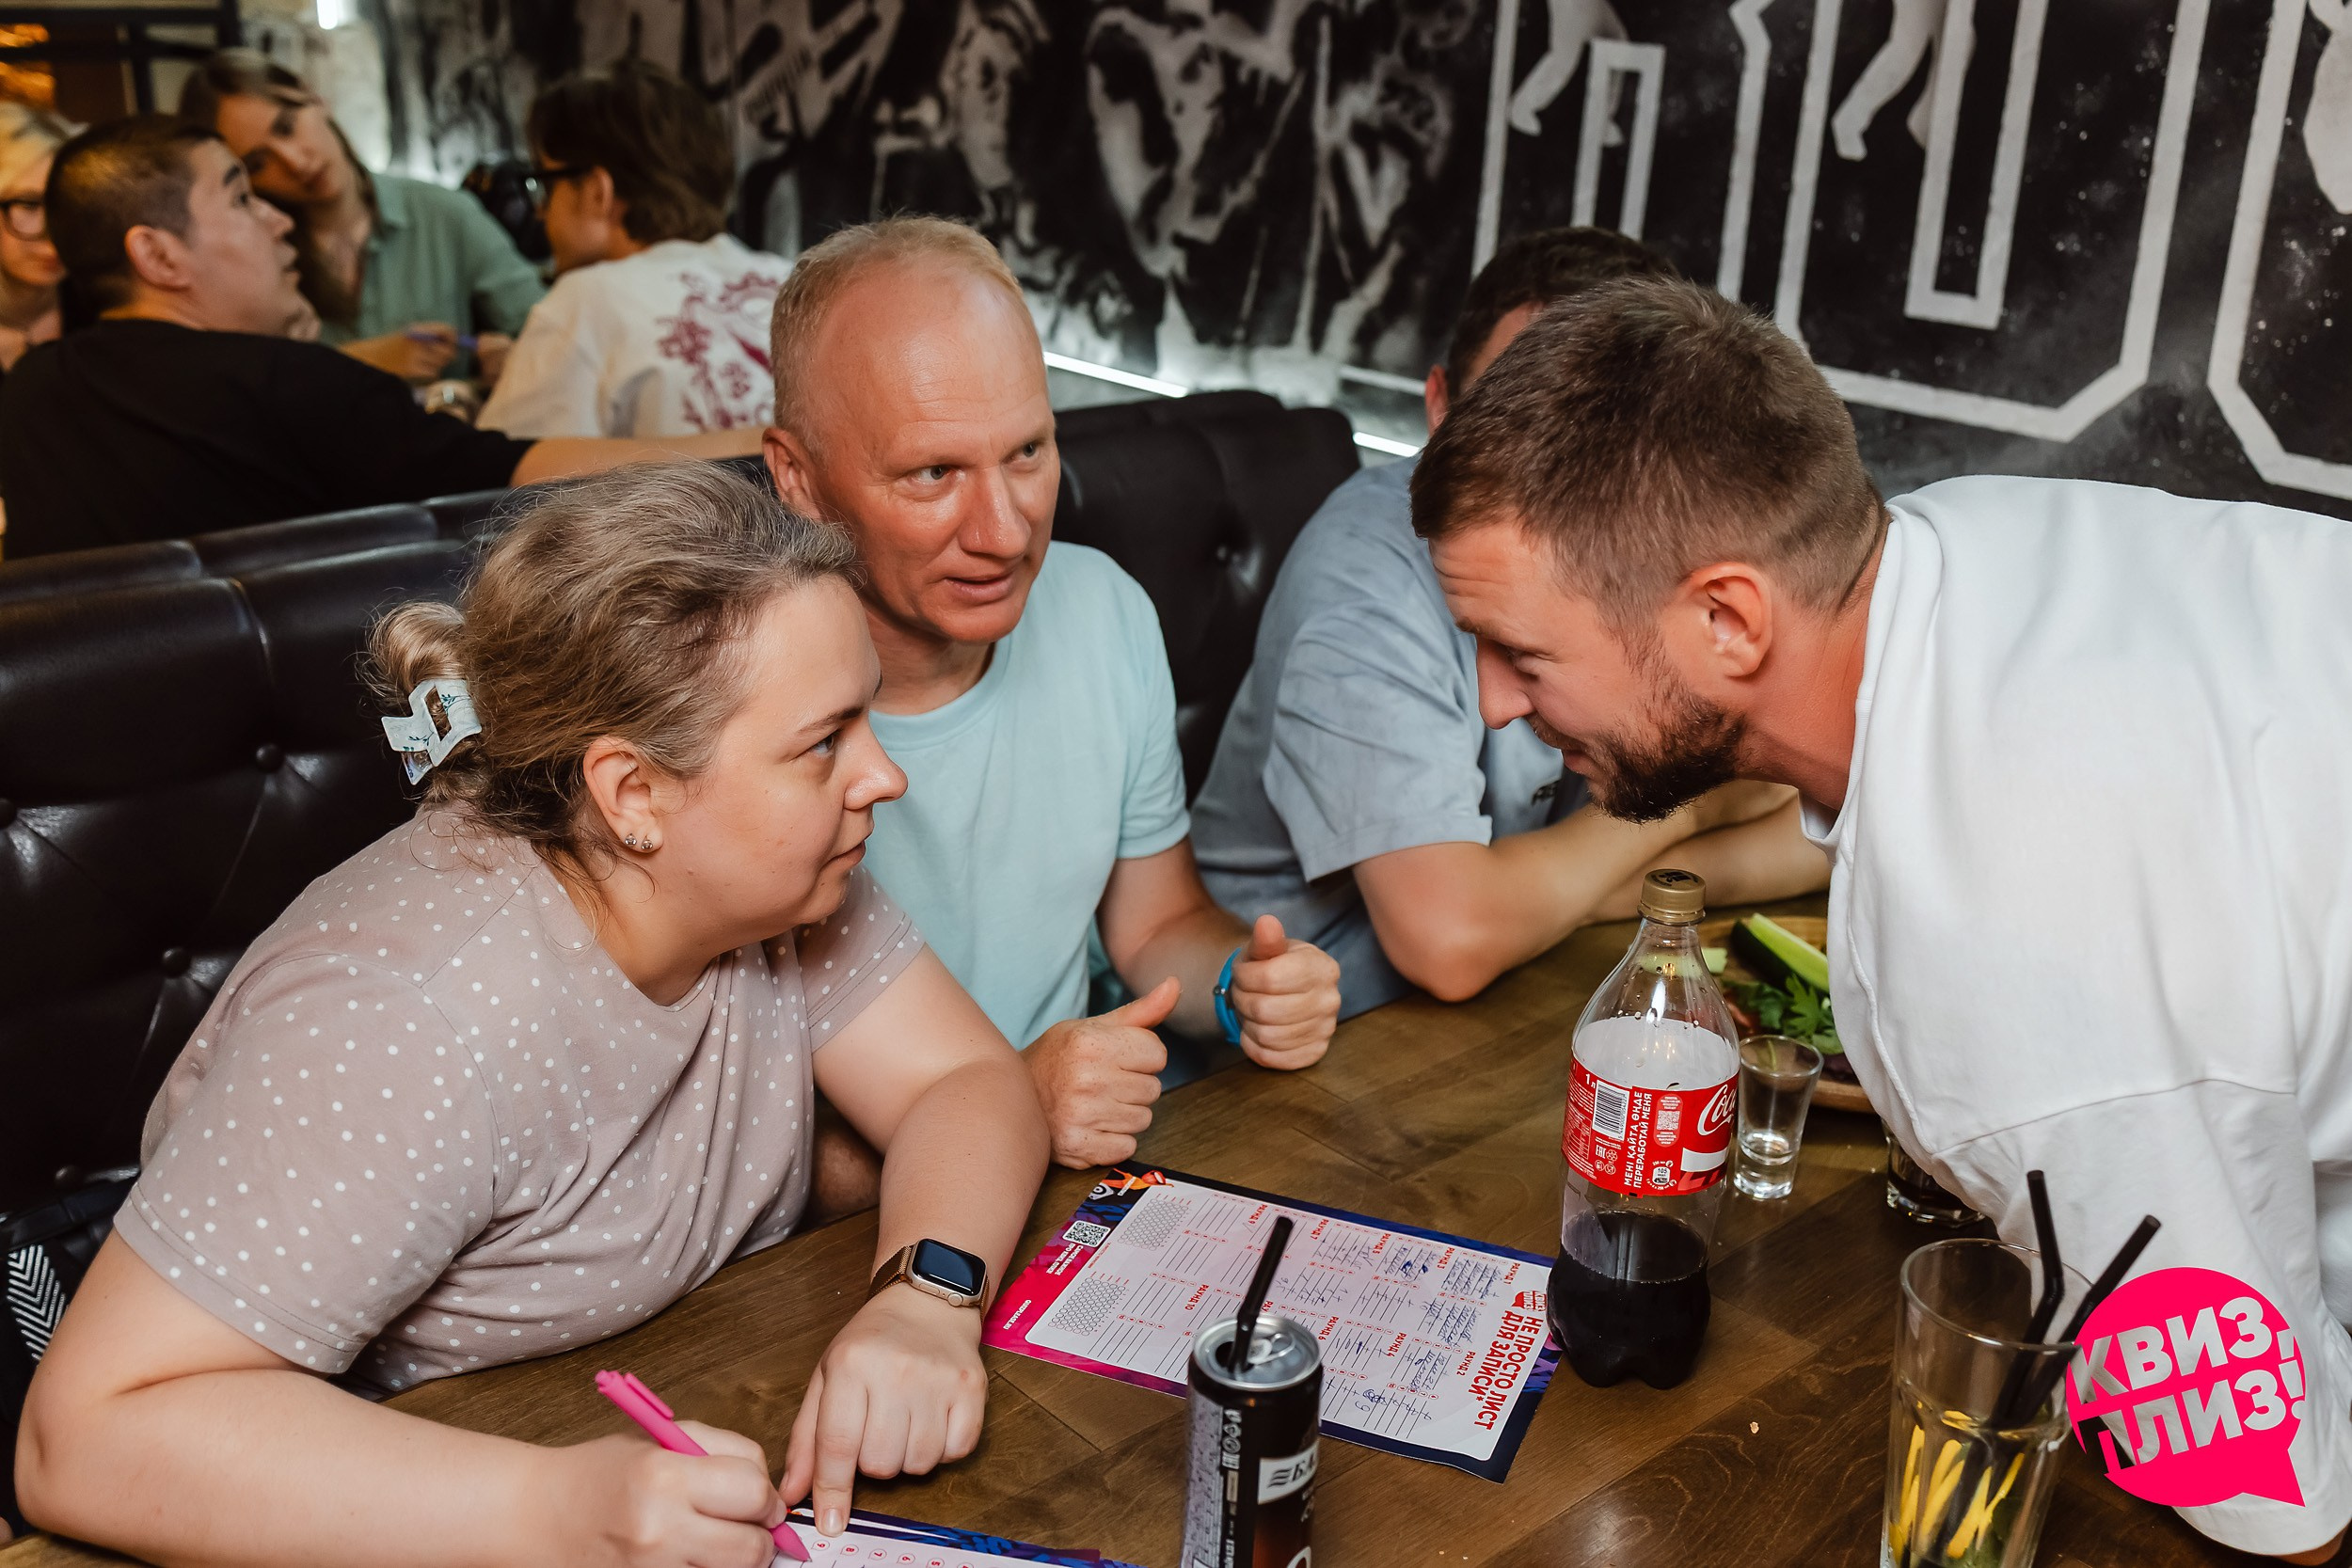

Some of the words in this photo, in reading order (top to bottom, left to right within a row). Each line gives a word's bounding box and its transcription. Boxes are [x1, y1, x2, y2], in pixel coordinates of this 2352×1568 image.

[1585, 1073, 1591, 1085] 1
[1632, 1091, 1643, 1121] ӨҢДЕ
[1629, 1123, 1640, 1161] ҚАЙТА
[1632, 1121, 1651, 1189] ПЕРЕРАБОТАЙ
[1643, 1092, 1653, 1120] МЕНЯ
[1624, 1160, 1635, 1186] МЕНІ
[1250, 1204, 1266, 1220] РАУНД
[1311, 1219, 1328, 1236] РАУНД
[1374, 1233, 1391, 1250] РАУНД
[1438, 1247, 1455, 1264] РАУНД
[1504, 1263, 1520, 1281] РАУНД
[1189, 1284, 1209, 1303] РАУНД
[1261, 1300, 1274, 1314] РАУ
[1321, 1316, 1338, 1336] РАУНД
[1497, 1310, 1524, 1340] ДЛЯ
[1520, 1316, 1543, 1335] НЕ
[1389, 1332, 1406, 1353] РАУНД
[1459, 1351, 1476, 1370] РАУНД
[1494, 1335, 1534, 1389] ПРОСТО
[1475, 1390, 1507, 1430] ЛИСТ
